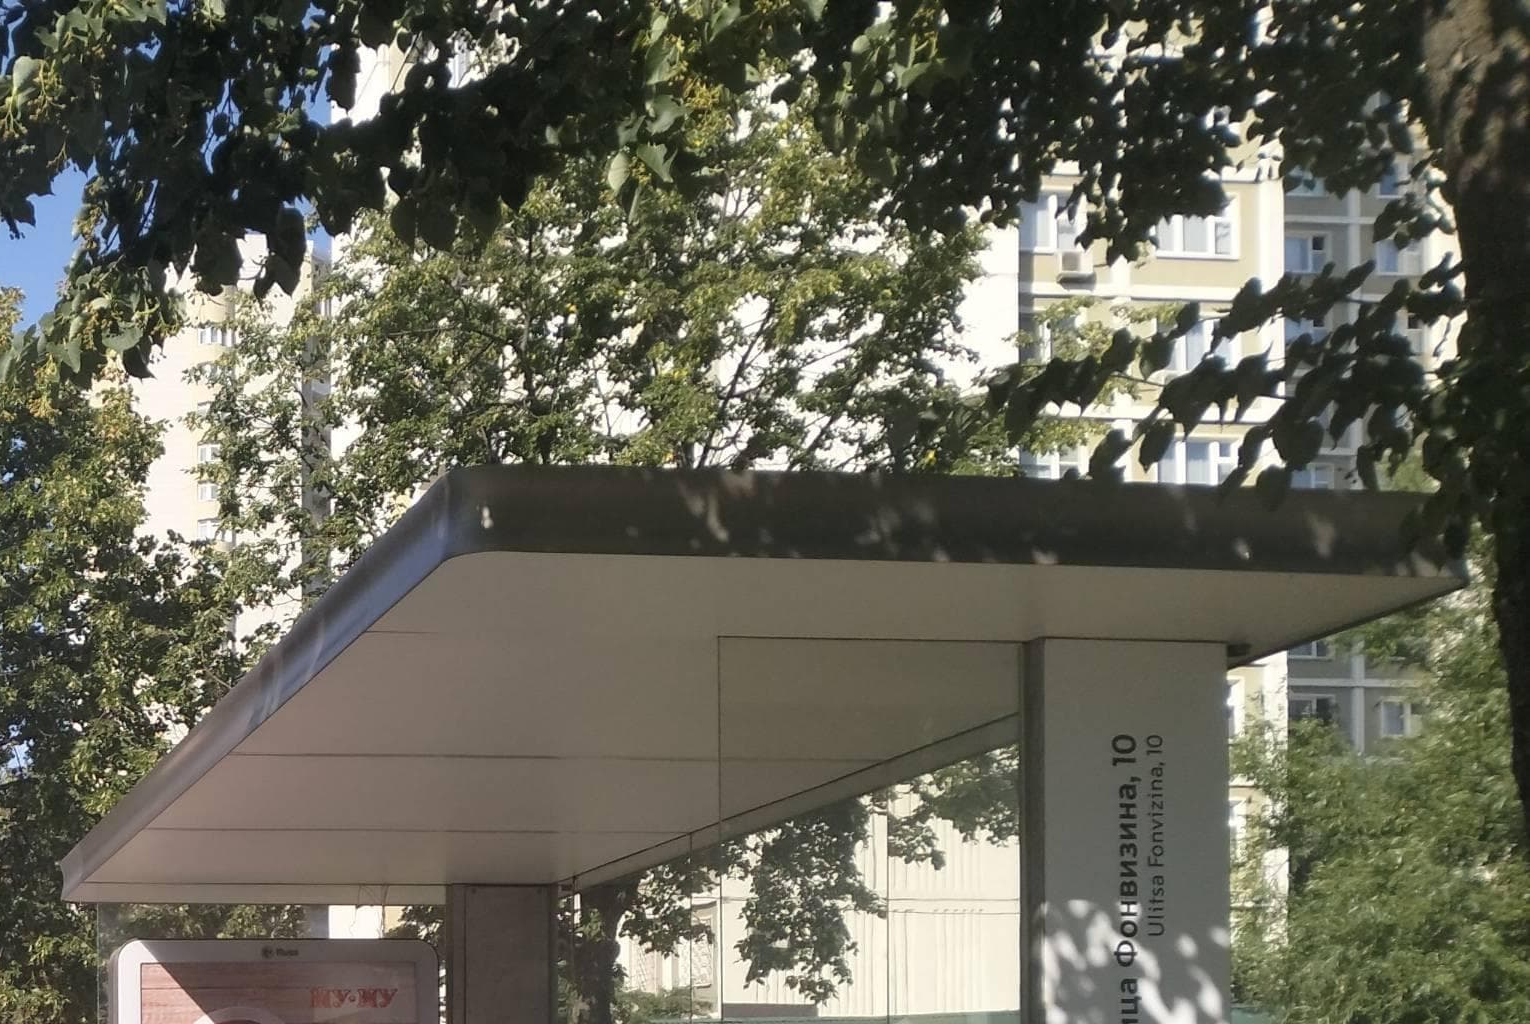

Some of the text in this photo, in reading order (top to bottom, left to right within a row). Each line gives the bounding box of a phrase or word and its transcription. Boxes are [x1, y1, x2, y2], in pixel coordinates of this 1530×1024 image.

[1111, 734, 1138, 768] 10
[1146, 734, 1167, 937] Ulitsa Fonvizina, 10
[1113, 775, 1142, 968] Фонвизина,
